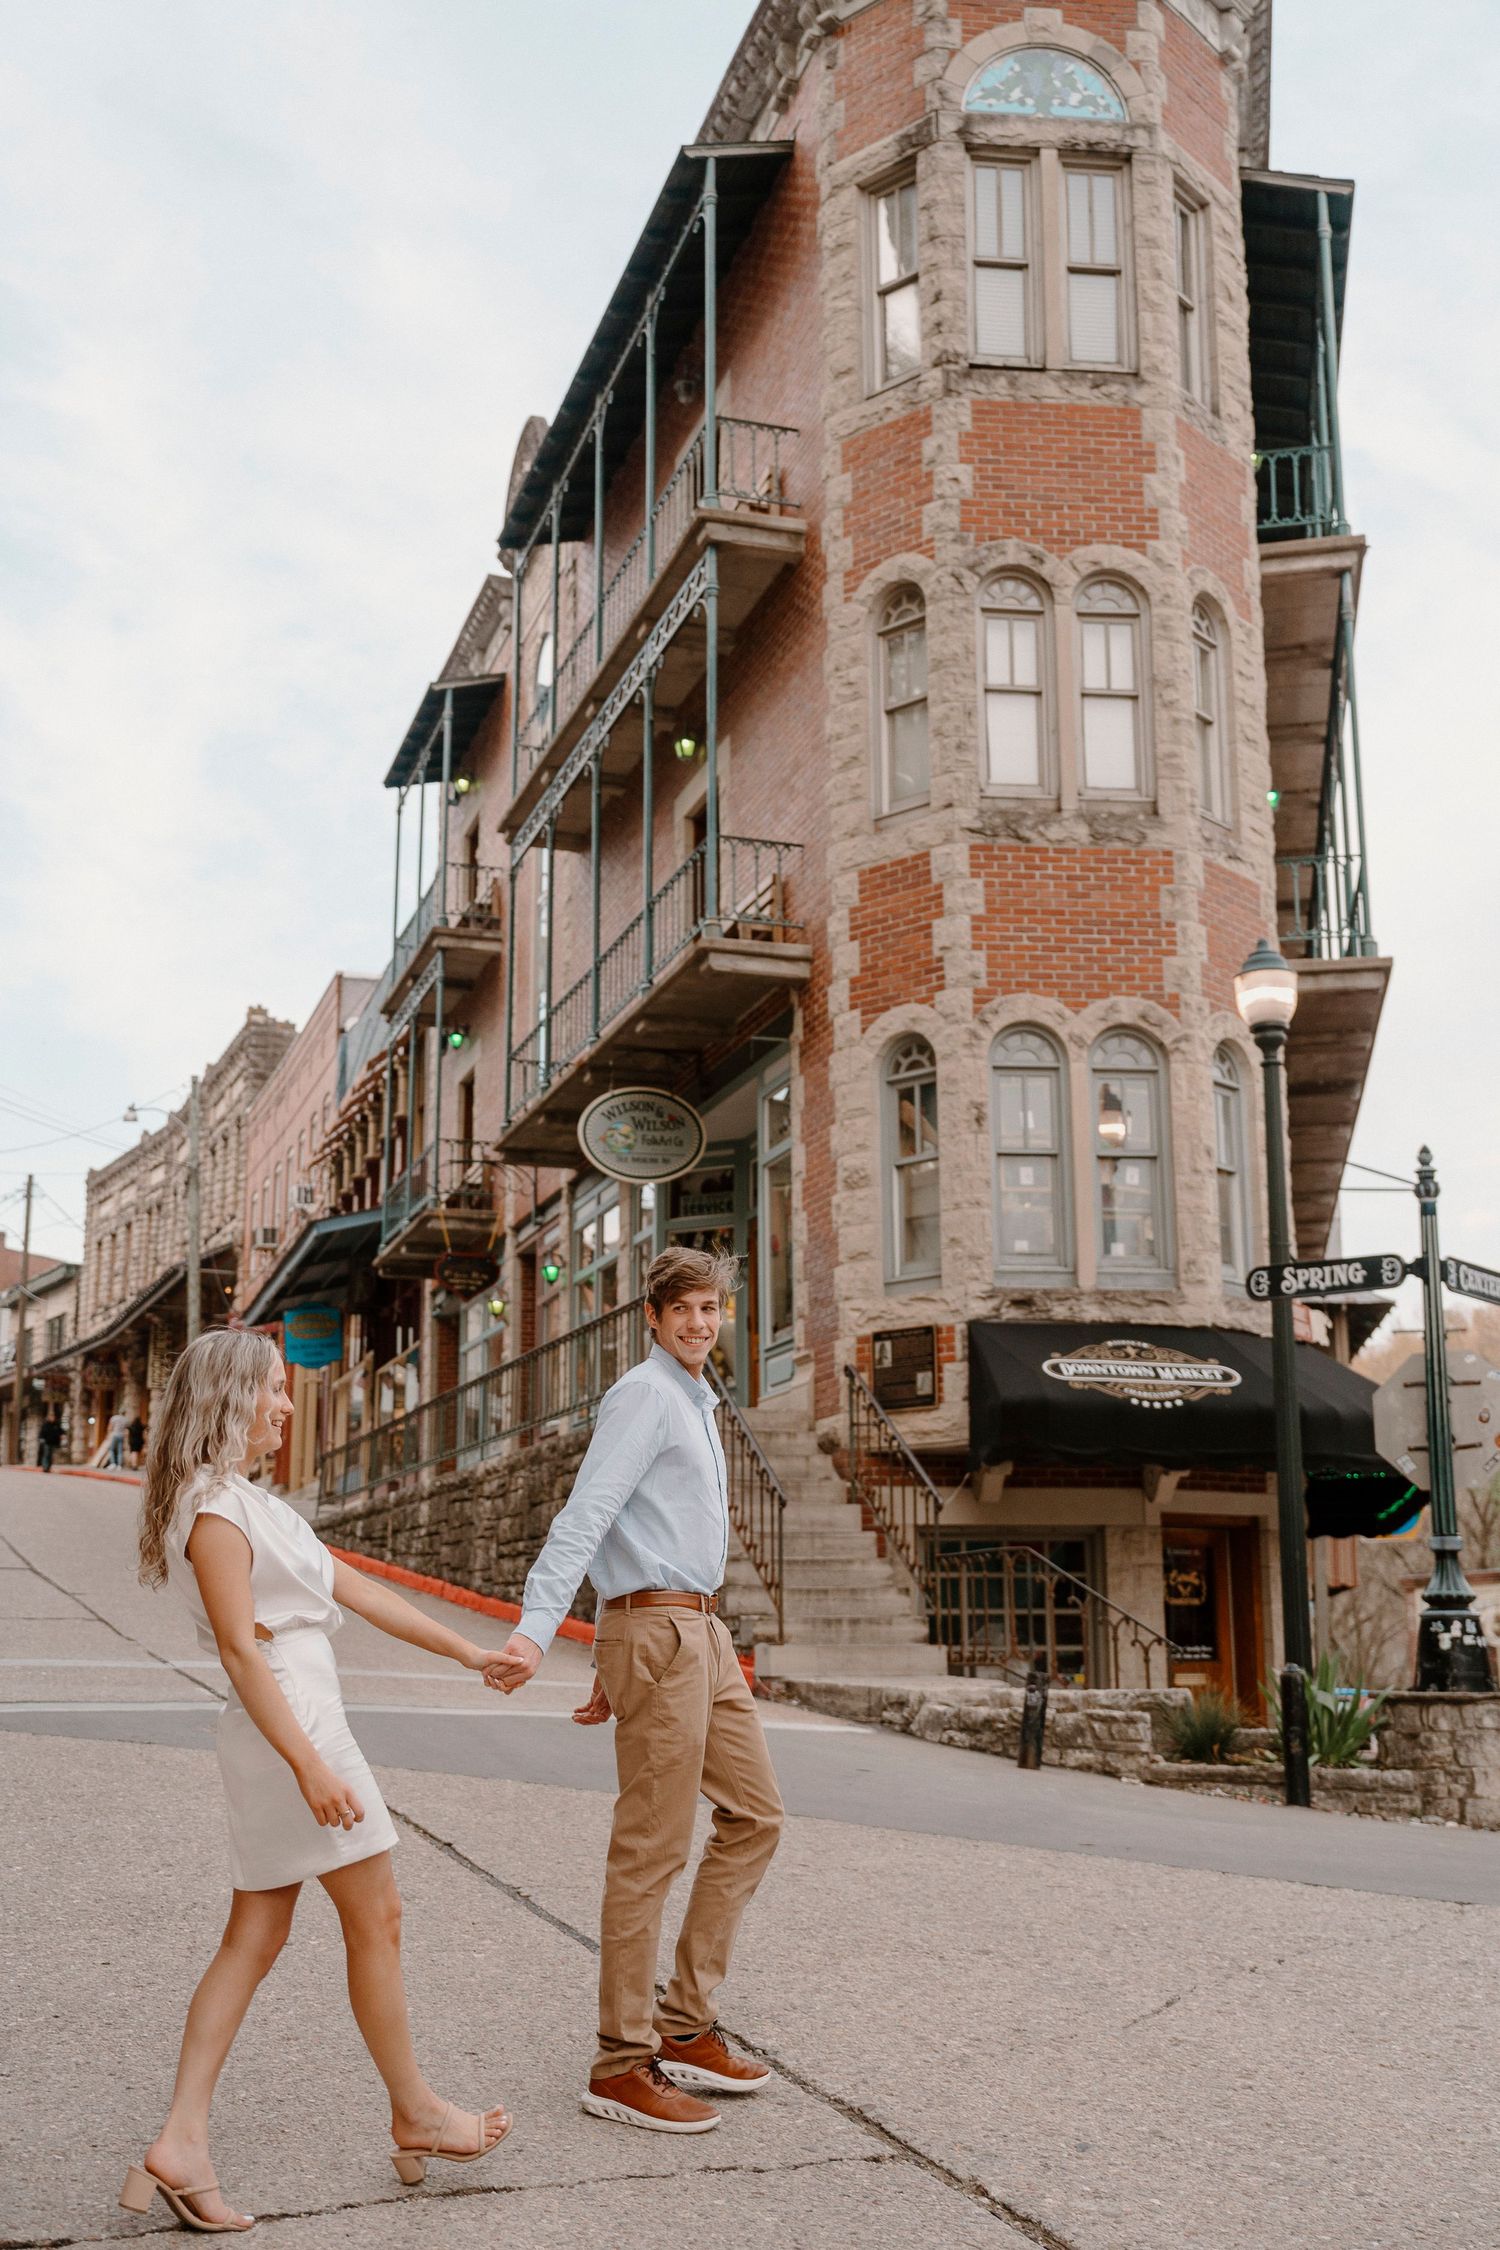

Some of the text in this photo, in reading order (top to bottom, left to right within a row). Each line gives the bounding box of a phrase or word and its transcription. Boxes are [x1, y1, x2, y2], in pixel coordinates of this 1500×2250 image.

[601, 1101, 655, 1120] WILSON
[630, 1115, 686, 1132] WILSON
[1280, 1261, 1368, 1295] SPRING
[1058, 1362, 1225, 1381] DOWNTOWN MARKET
